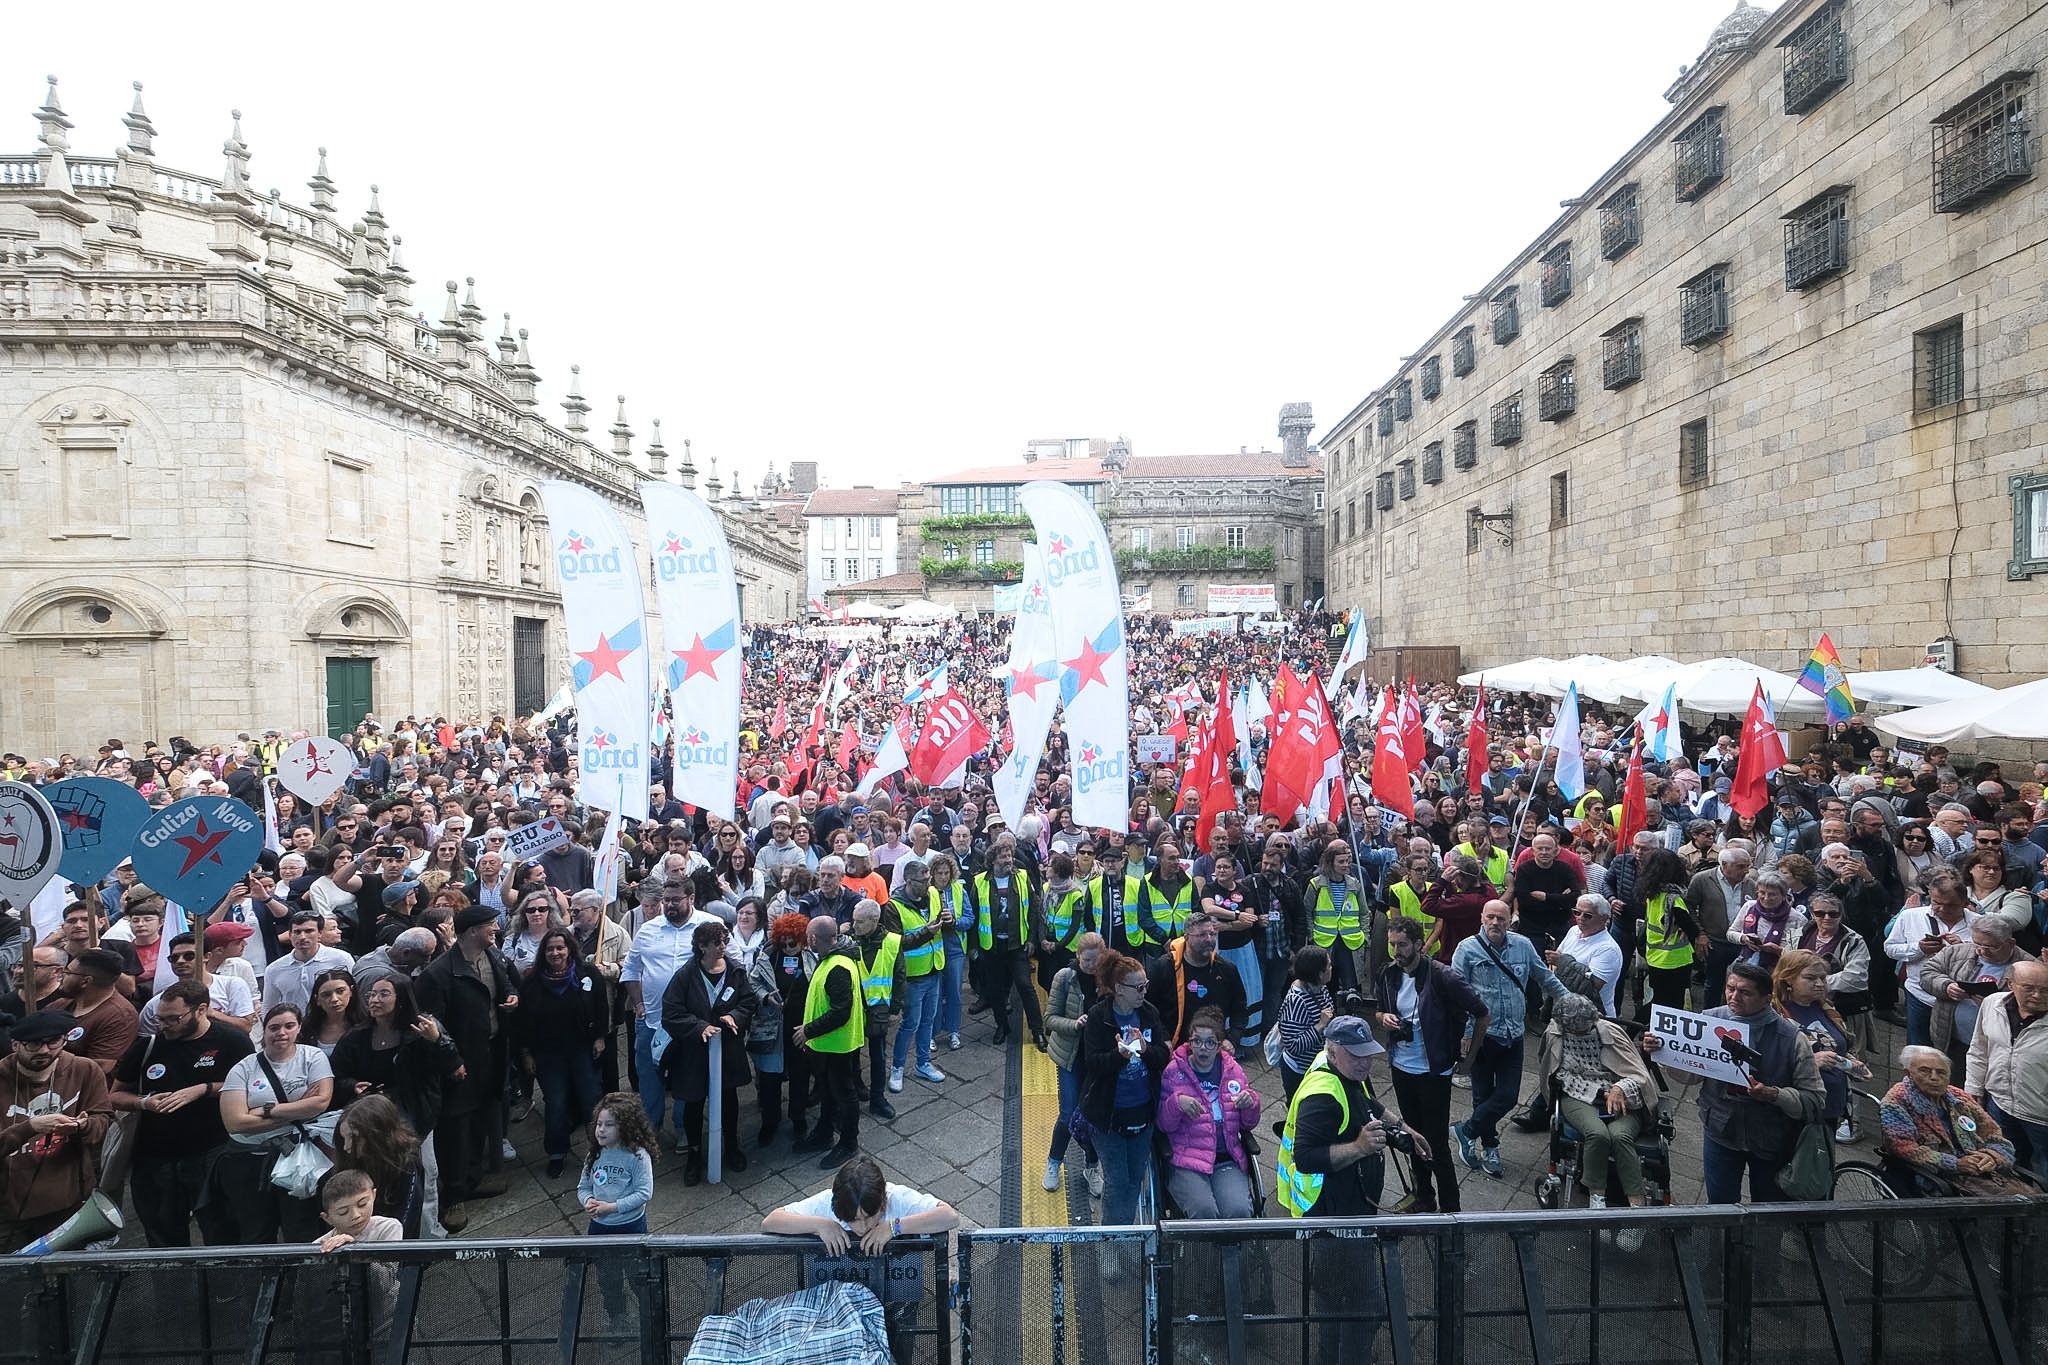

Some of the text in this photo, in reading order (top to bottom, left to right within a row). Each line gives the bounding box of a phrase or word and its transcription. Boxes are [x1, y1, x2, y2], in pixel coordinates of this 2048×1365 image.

[140, 801, 254, 848] Galiza Nova
[508, 825, 538, 847] EU
[514, 847, 523, 855] O
[523, 831, 563, 851] GALEGO
[1654, 1011, 1708, 1041] EU
[1668, 1039, 1743, 1067] GALEG
